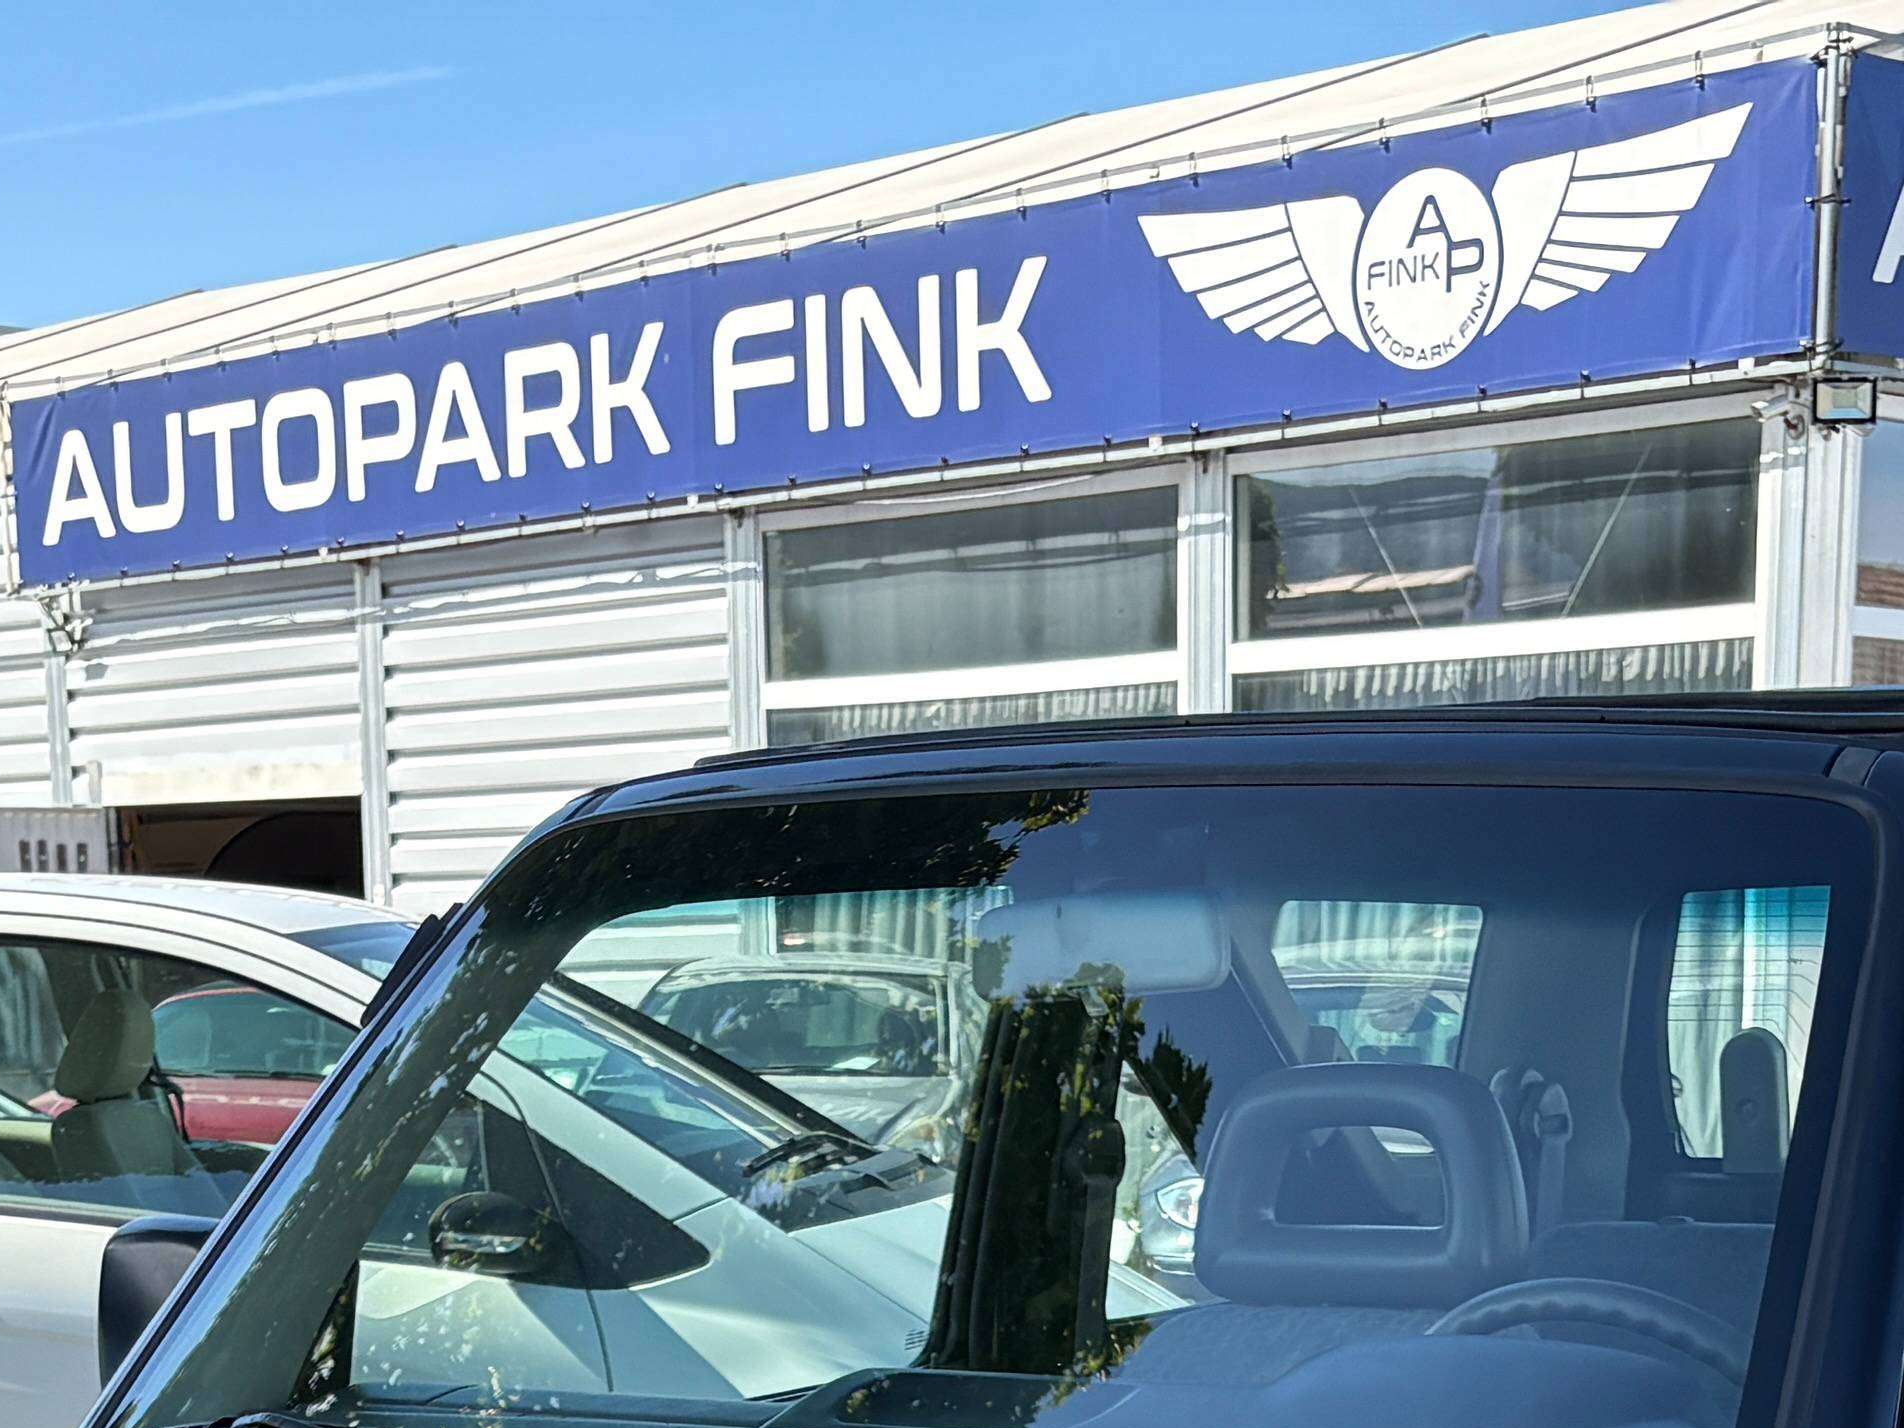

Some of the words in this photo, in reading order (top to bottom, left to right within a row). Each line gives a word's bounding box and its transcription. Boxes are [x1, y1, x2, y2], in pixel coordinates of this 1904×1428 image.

[1368, 251, 1441, 290] FINK
[1364, 300, 1456, 361] AUTOPARK
[1460, 280, 1490, 338] FINK
[43, 322, 670, 546] AUTOPARK
[713, 255, 1052, 446] FINK
